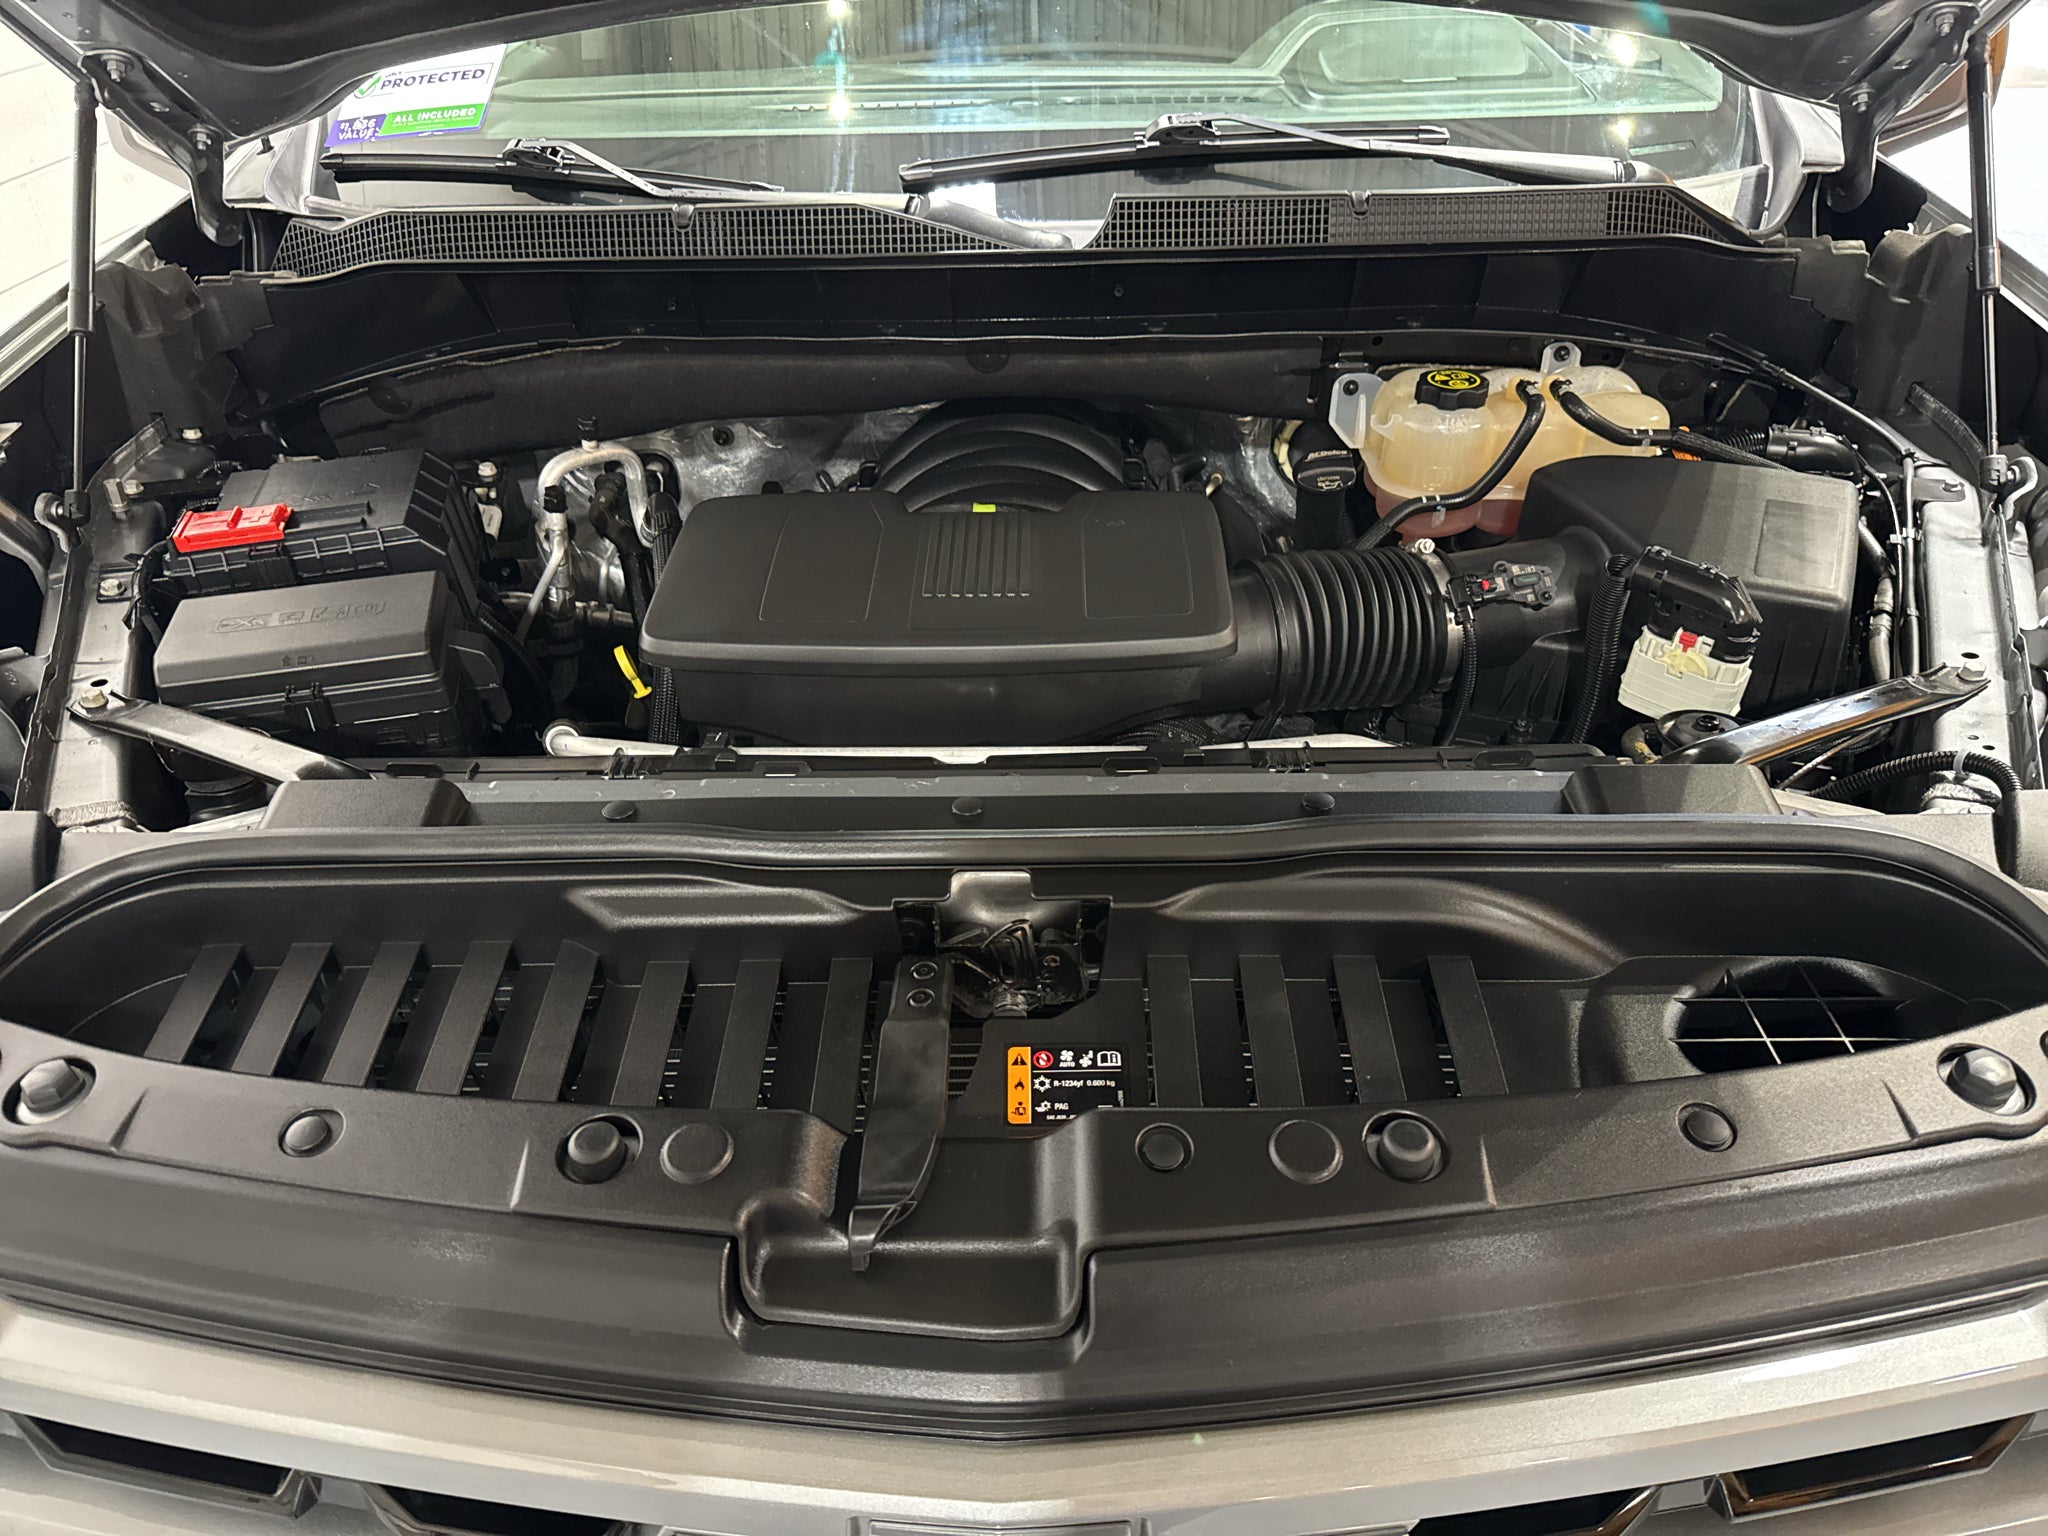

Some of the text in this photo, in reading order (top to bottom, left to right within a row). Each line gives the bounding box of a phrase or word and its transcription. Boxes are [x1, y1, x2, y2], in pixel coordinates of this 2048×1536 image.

[380, 68, 485, 90] PROTECTED
[393, 113, 414, 124] ALL
[416, 107, 477, 121] INCLUDED
[1307, 449, 1348, 461] ACDelco
[1053, 1080, 1084, 1088] R-1234yf
[1107, 1079, 1116, 1088] kg
[1054, 1102, 1069, 1111] PAG
